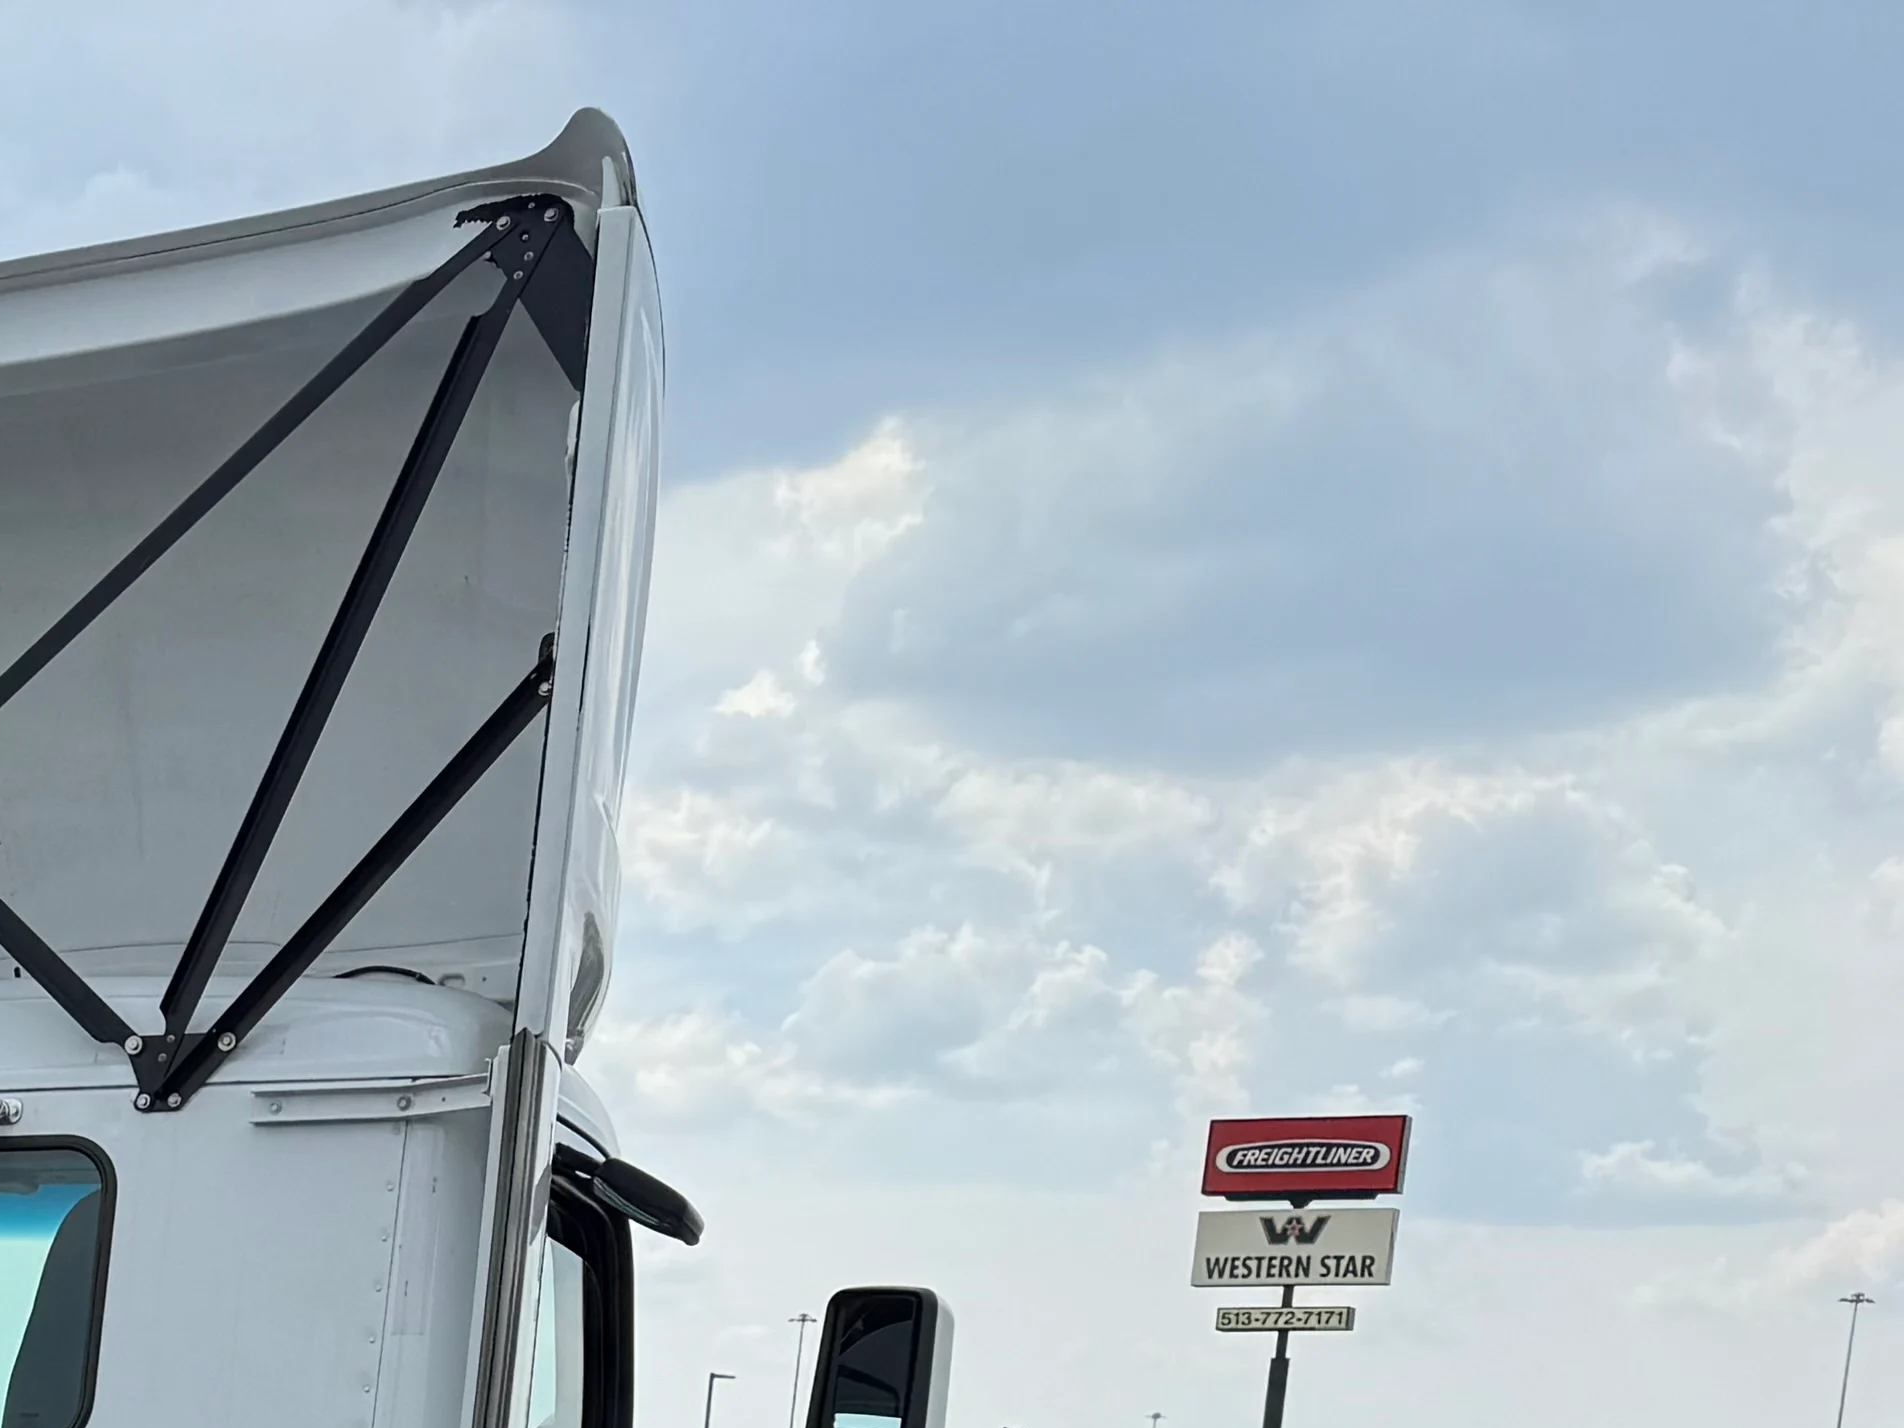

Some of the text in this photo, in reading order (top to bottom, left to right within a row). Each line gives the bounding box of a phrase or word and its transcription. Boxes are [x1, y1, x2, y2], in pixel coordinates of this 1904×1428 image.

[1232, 1146, 1375, 1166] FREIGHTLINER
[1205, 1254, 1376, 1280] WESTERN STAR
[1220, 1310, 1344, 1328] 513-772-7171
